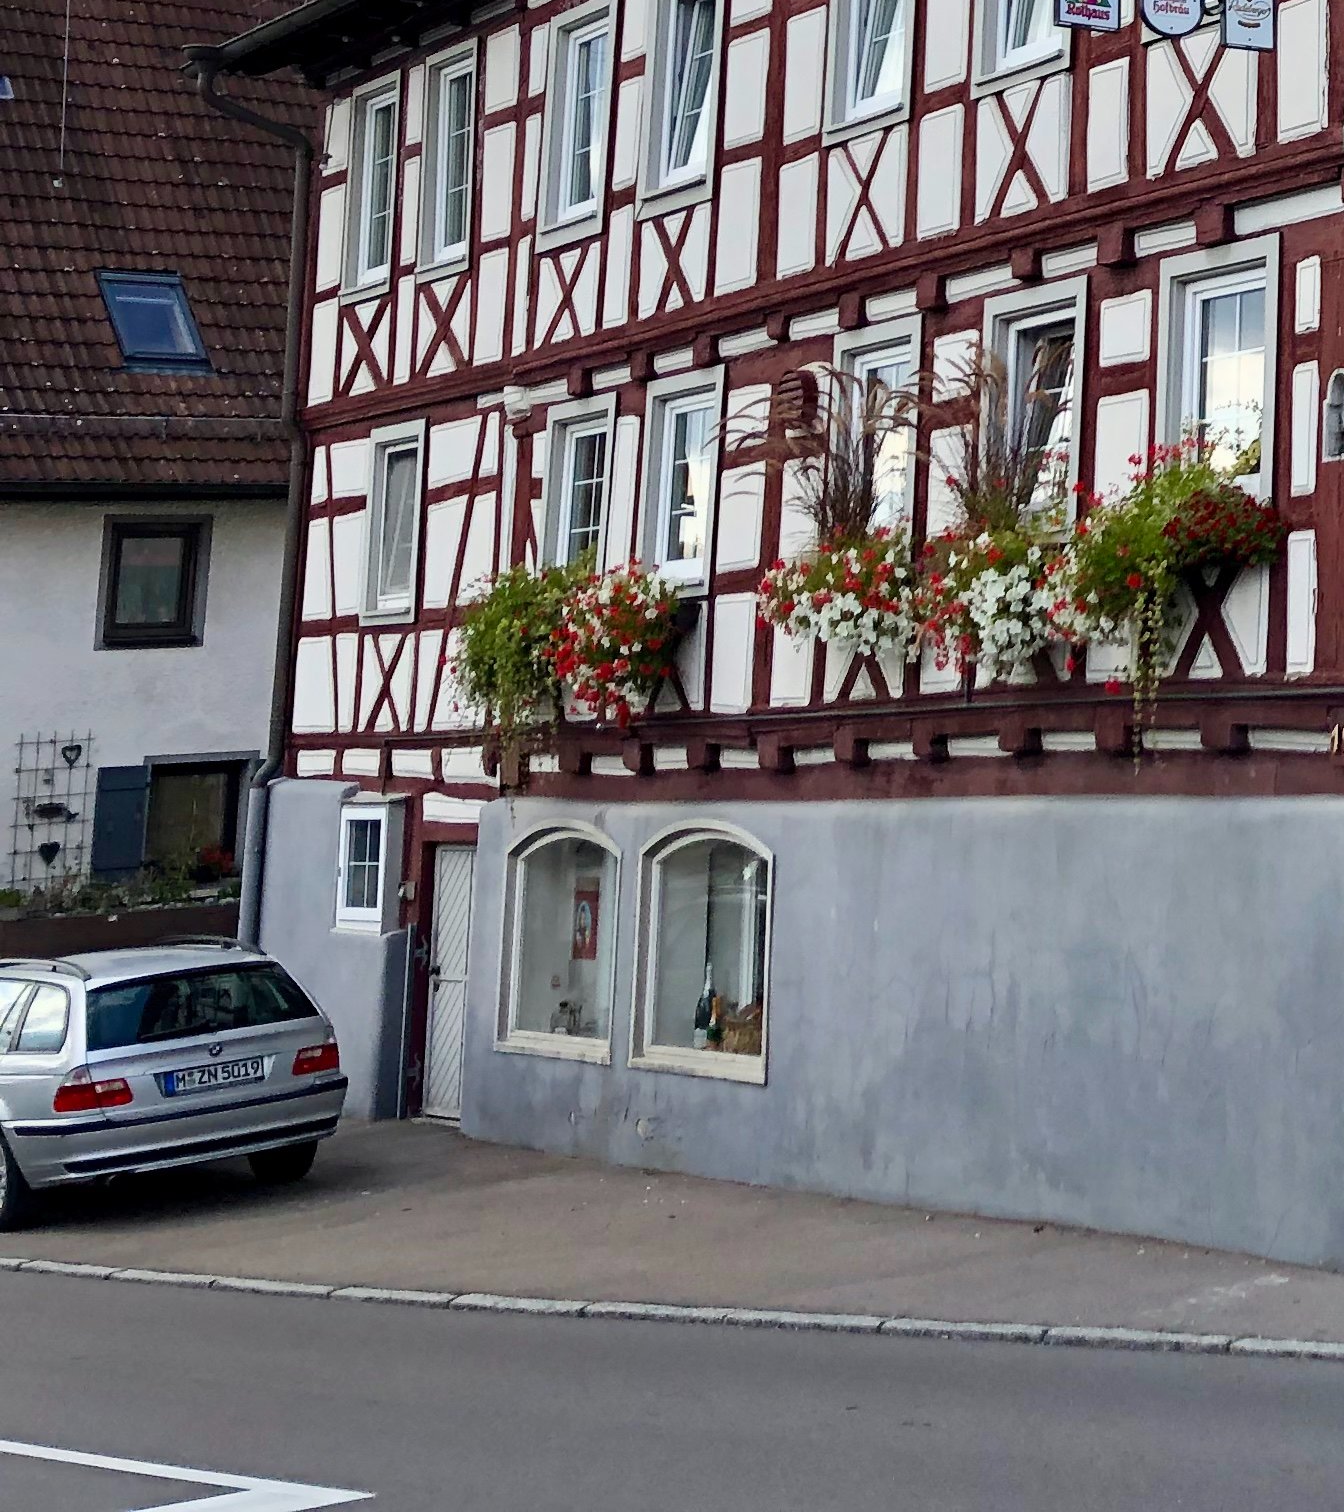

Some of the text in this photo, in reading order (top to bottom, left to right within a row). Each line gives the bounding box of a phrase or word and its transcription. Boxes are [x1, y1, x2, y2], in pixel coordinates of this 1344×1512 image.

[1065, 2, 1111, 21] Rothaus
[197, 1066, 218, 1085] ZN
[221, 1060, 260, 1081] 5019
